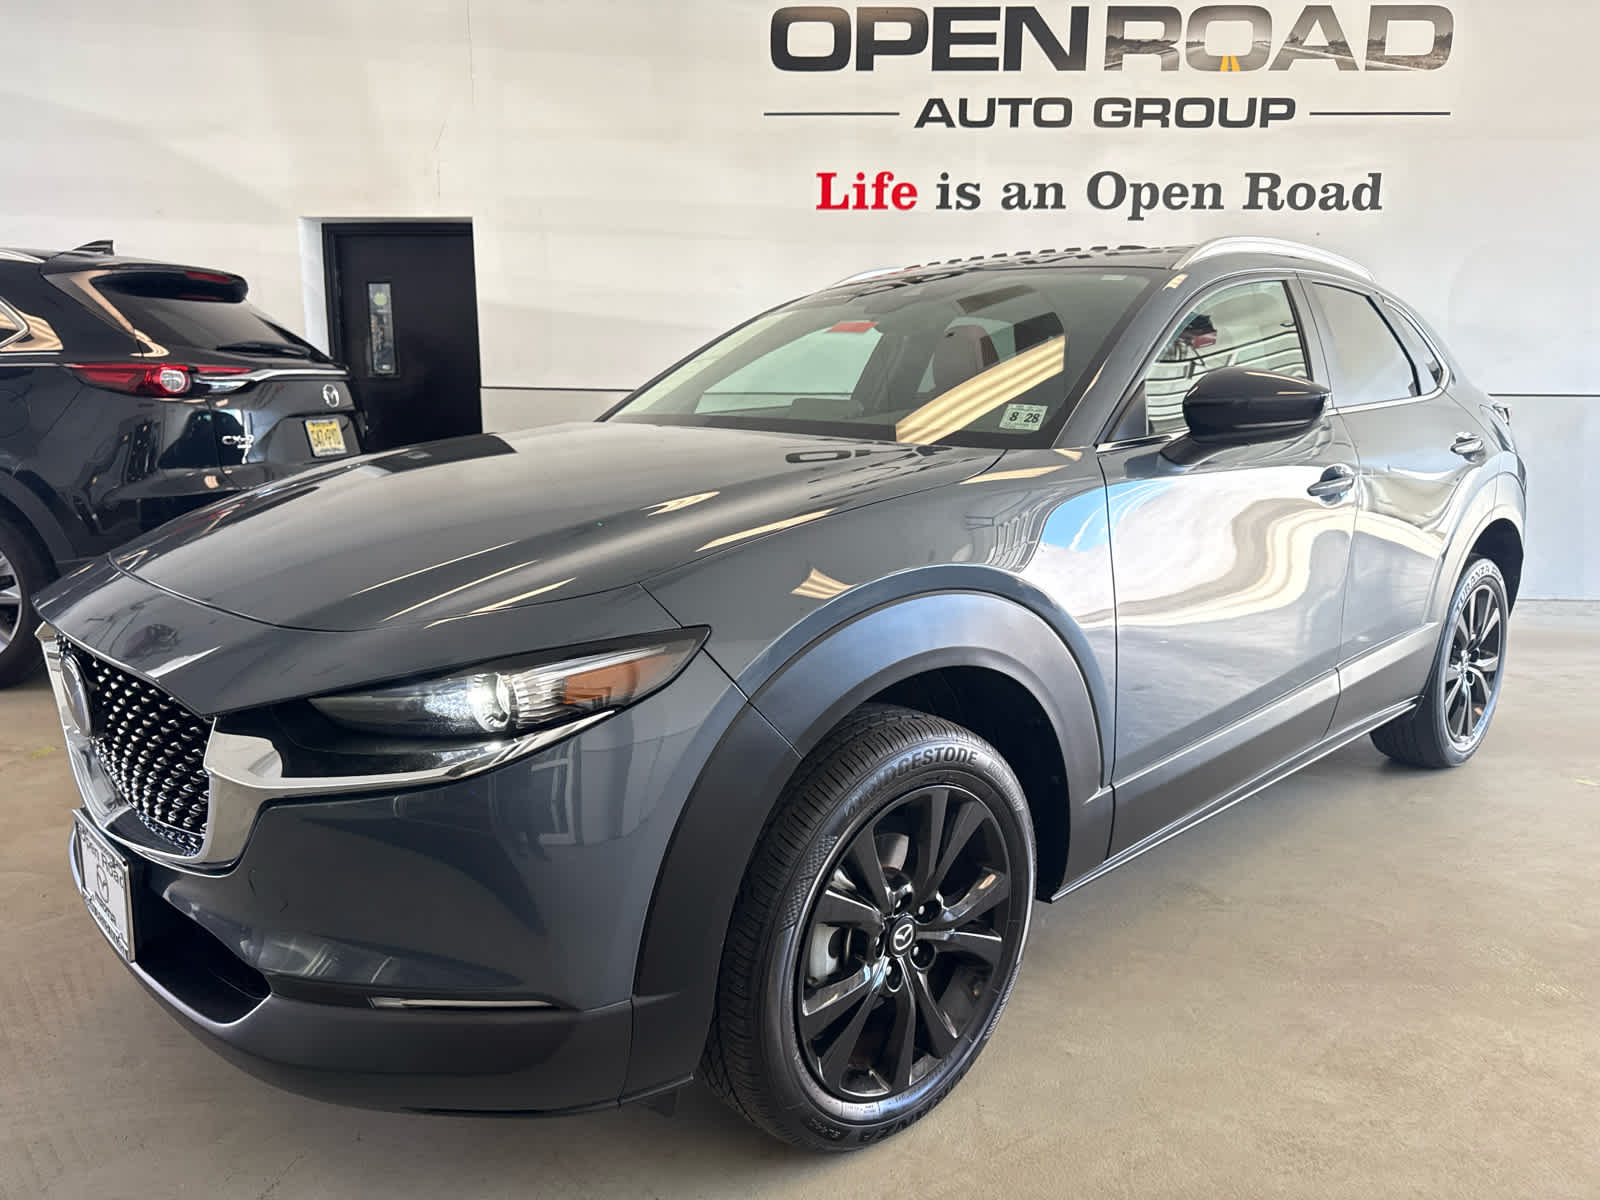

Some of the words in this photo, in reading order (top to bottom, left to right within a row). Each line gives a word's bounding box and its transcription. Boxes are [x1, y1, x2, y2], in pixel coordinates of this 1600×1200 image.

[770, 6, 1089, 72] OPEN
[1104, 5, 1454, 72] ROAD
[914, 97, 1073, 128] AUTO
[1093, 97, 1296, 128] GROUP
[816, 171, 918, 210] Life
[936, 172, 980, 210] is
[1001, 183, 1067, 210] an
[1087, 171, 1225, 221] Open
[1242, 172, 1383, 211] Road
[1010, 411, 1019, 421] 8
[1024, 413, 1040, 424] 28
